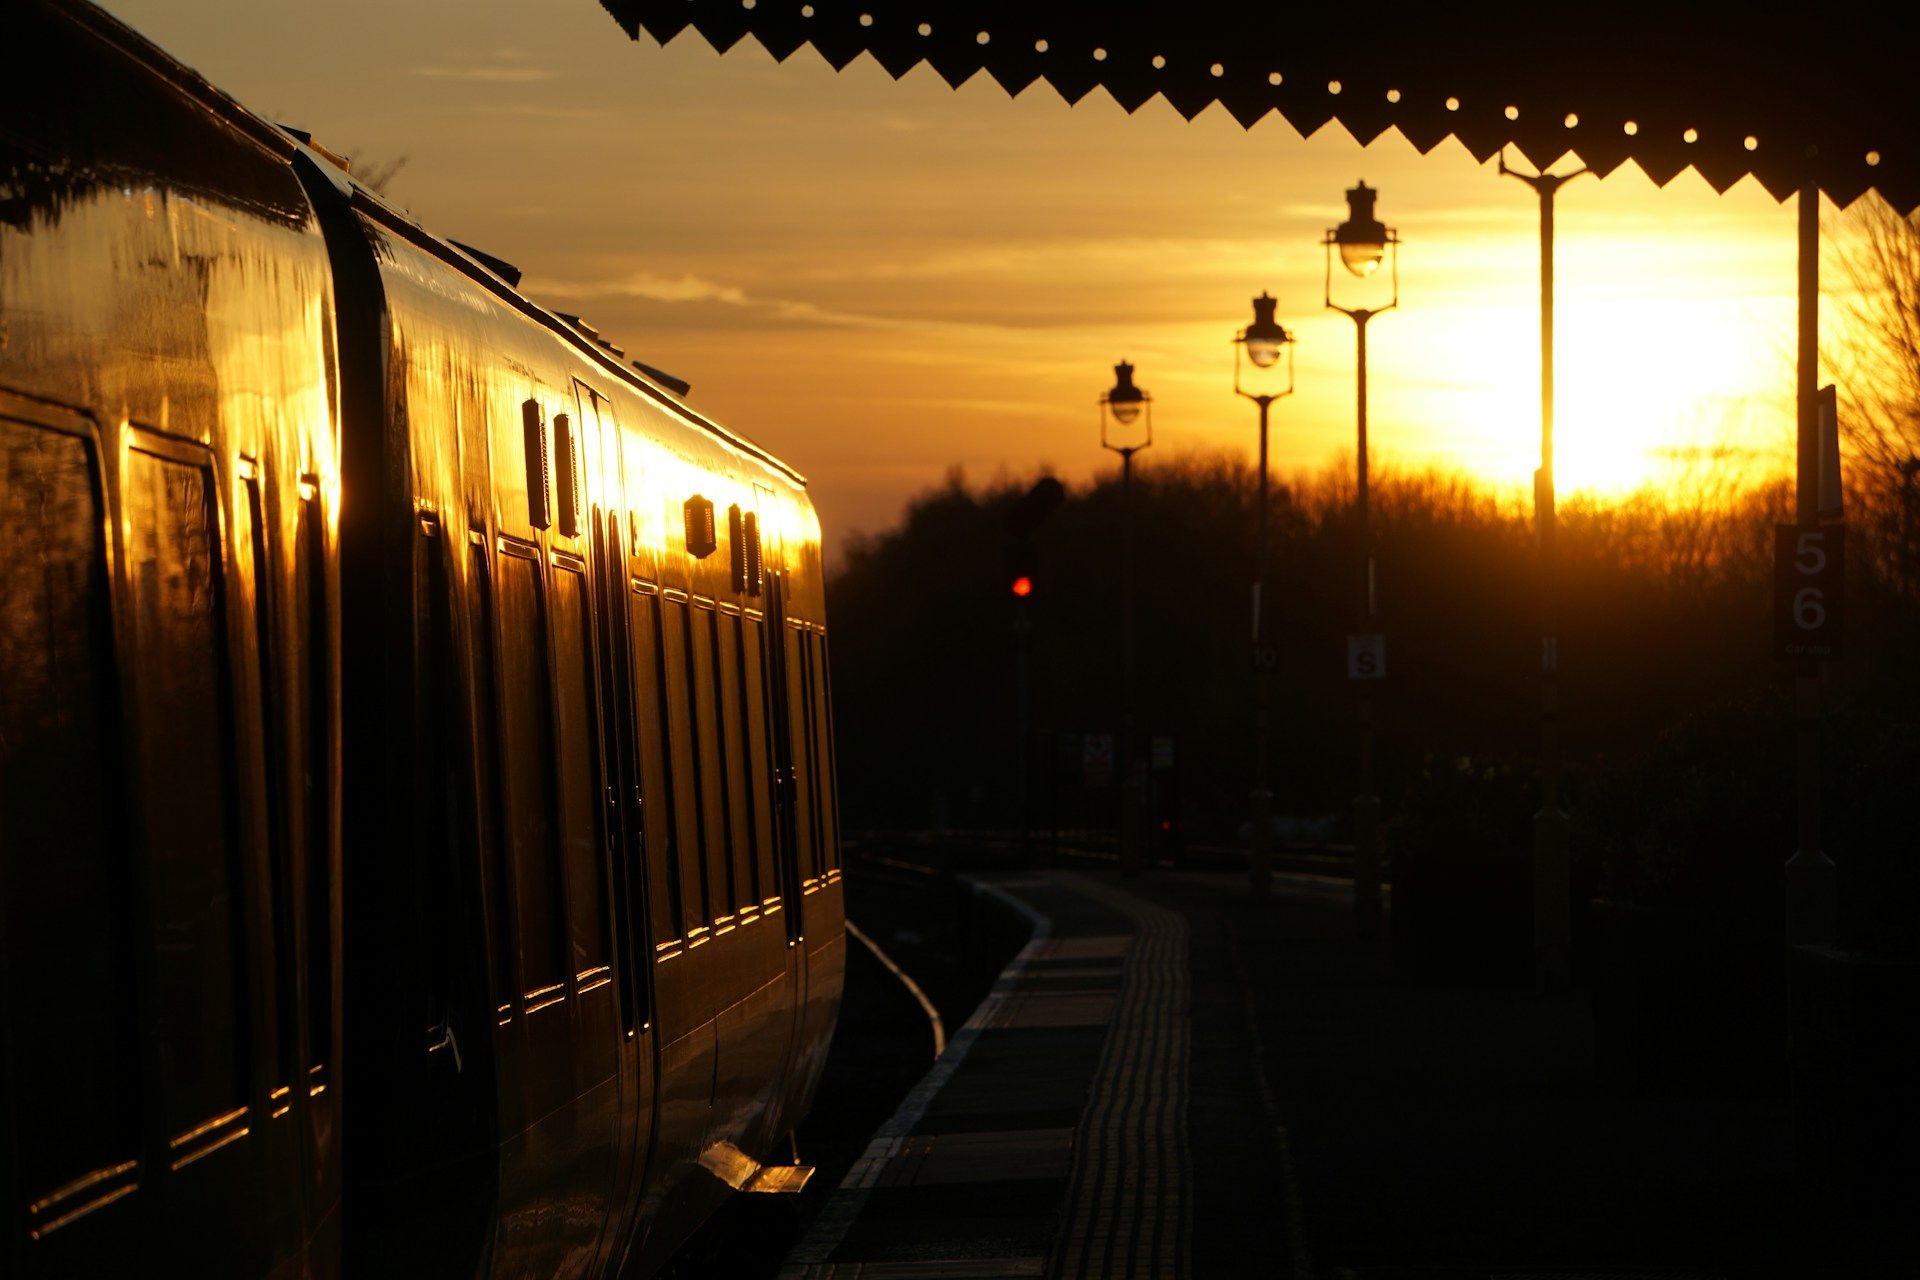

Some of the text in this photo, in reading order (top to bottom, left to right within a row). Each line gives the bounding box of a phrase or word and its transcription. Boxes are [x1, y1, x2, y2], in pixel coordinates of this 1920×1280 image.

[1793, 532, 1826, 576] 5
[1792, 586, 1827, 631] 6
[1357, 651, 1376, 674] S
